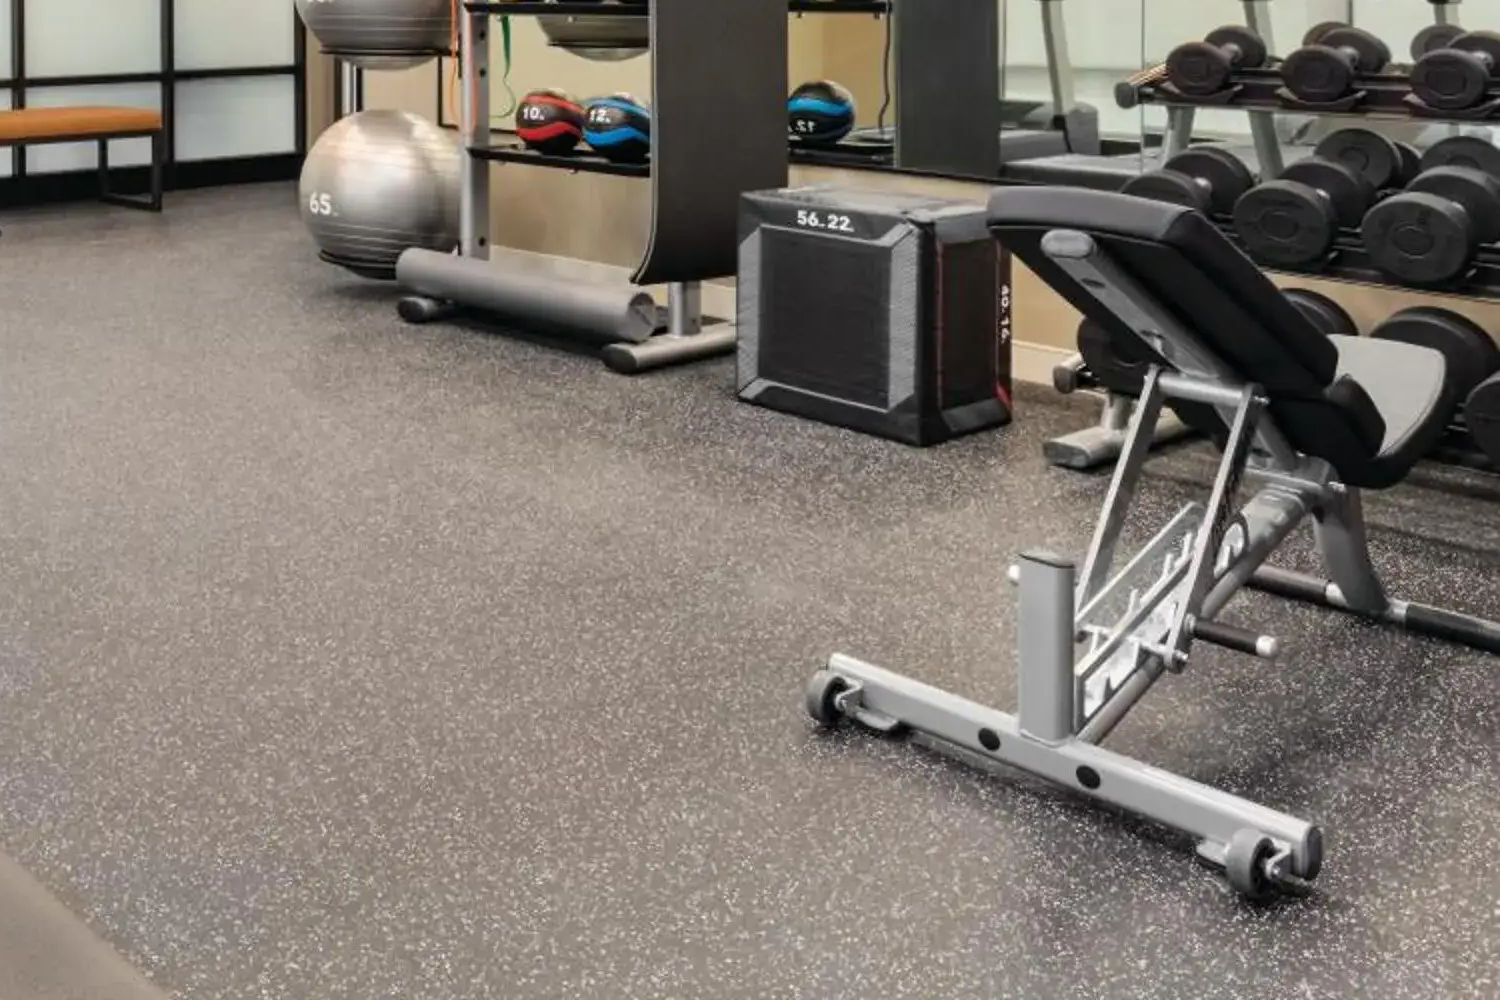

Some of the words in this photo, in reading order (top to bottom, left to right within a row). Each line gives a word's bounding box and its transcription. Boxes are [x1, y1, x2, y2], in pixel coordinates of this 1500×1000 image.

[523, 107, 540, 120] 10
[590, 109, 607, 123] 12
[310, 191, 331, 215] 65
[797, 210, 819, 227] 56
[827, 214, 854, 232] 22
